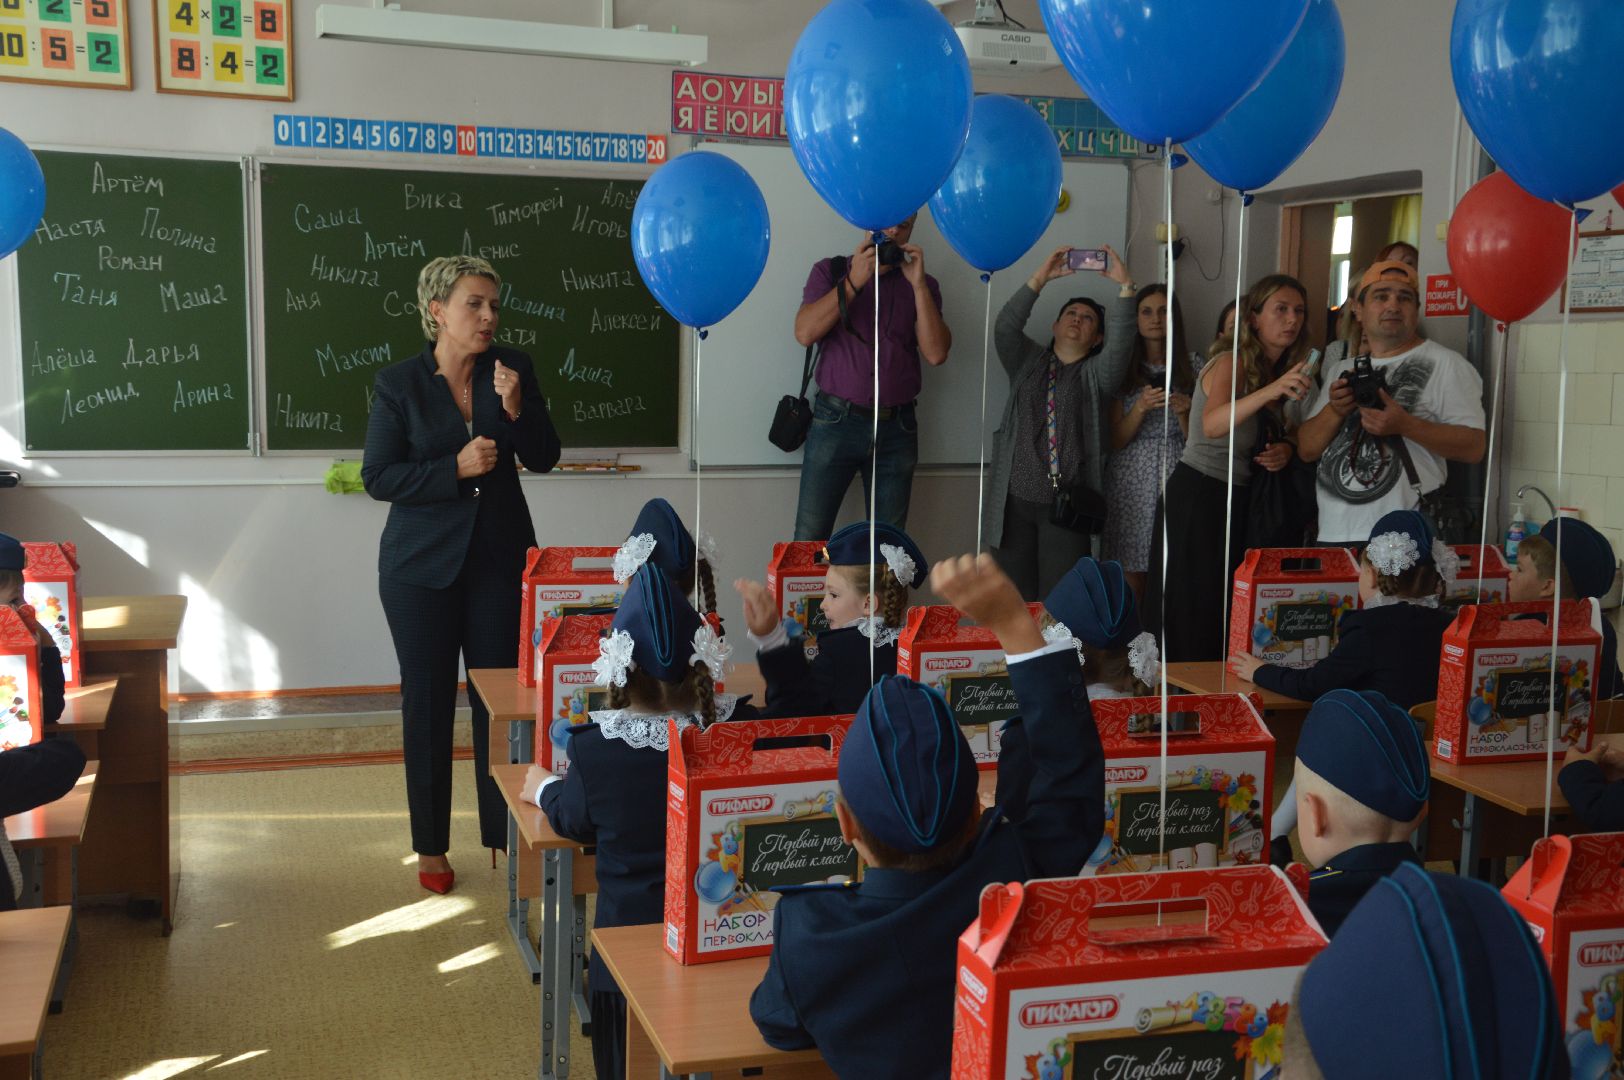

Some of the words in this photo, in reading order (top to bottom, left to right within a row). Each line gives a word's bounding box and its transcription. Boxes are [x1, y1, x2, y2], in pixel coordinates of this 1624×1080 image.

[175, 2, 194, 26] 4
[219, 5, 236, 31] 2
[260, 9, 277, 34] 8
[50, 36, 68, 62] 5
[94, 40, 113, 65] 2
[1001, 34, 1031, 43] CASIO
[178, 47, 195, 72] 8
[220, 51, 238, 75] 4
[262, 54, 279, 79] 2
[278, 119, 290, 141] 0
[298, 120, 306, 142] 1
[316, 122, 327, 144] 2
[335, 123, 345, 145] 3
[352, 124, 364, 145] 4
[371, 125, 382, 147] 5
[389, 126, 400, 147] 6
[407, 127, 418, 148] 7
[425, 127, 436, 149] 8
[442, 128, 453, 150] 9
[459, 129, 475, 152] 10
[478, 131, 494, 153] 11
[499, 132, 514, 154] 12
[517, 132, 533, 155] 13
[536, 133, 553, 155] 14
[556, 134, 572, 156] 15
[575, 135, 591, 157] 16
[594, 136, 609, 158] 17
[611, 137, 627, 159] 18
[629, 138, 645, 160] 19
[647, 139, 665, 161] 20
[92, 161, 164, 197] Артём
[404, 184, 463, 210] Вика
[486, 187, 564, 227] Тимофей
[601, 182, 639, 210] Алё
[35, 217, 107, 244] Настя
[141, 207, 216, 253] Полина
[294, 203, 362, 233] Саша
[572, 204, 627, 238] Игорь
[99, 246, 163, 271] Роман
[365, 232, 426, 262] Артём
[311, 254, 380, 287] Никита
[561, 267, 634, 292] Никита
[1435, 280, 1449, 288] ПРИ
[54, 272, 117, 306] Таня
[160, 282, 228, 312] Маша
[286, 287, 321, 313] Аня
[498, 281, 566, 322] Полина
[1427, 291, 1456, 300] ПОЖАРЕ
[590, 305, 662, 334] Алексей
[1427, 303, 1455, 312] ЗВОНИТЬ
[492, 327, 536, 345] атя
[32, 340, 97, 376] Алёша
[122, 338, 200, 369] Дарья
[316, 343, 391, 377] Максим
[559, 347, 613, 387] Даша
[61, 382, 140, 424] Леонид
[173, 380, 234, 412] Арина
[573, 395, 646, 422] Варвара
[274, 393, 343, 432] Никита
[543, 592, 579, 600] ПИФАГОР
[789, 583, 823, 591] ПИФАГОР
[929, 659, 970, 669] ПИФАГОР
[1481, 655, 1516, 665] ПИФАГОР
[563, 672, 599, 683] ПИФАГ
[1471, 733, 1509, 744] НАБОР
[1105, 769, 1145, 781] ФАГОР
[712, 797, 771, 813] ПИФАГОР
[1189, 806, 1212, 821] раз
[1127, 820, 1140, 837] в
[1179, 818, 1220, 834] класс!
[759, 828, 820, 857] Первый
[751, 857, 763, 873] в
[763, 848, 807, 876] первый
[809, 848, 853, 867] класс!
[704, 913, 767, 933] НАБОР
[704, 931, 775, 948] ПЕРВОКЛА
[1025, 1001, 1115, 1025] ПИФАГОР
[1094, 1047, 1187, 1080] Первый
[1187, 1056, 1224, 1080] раз
